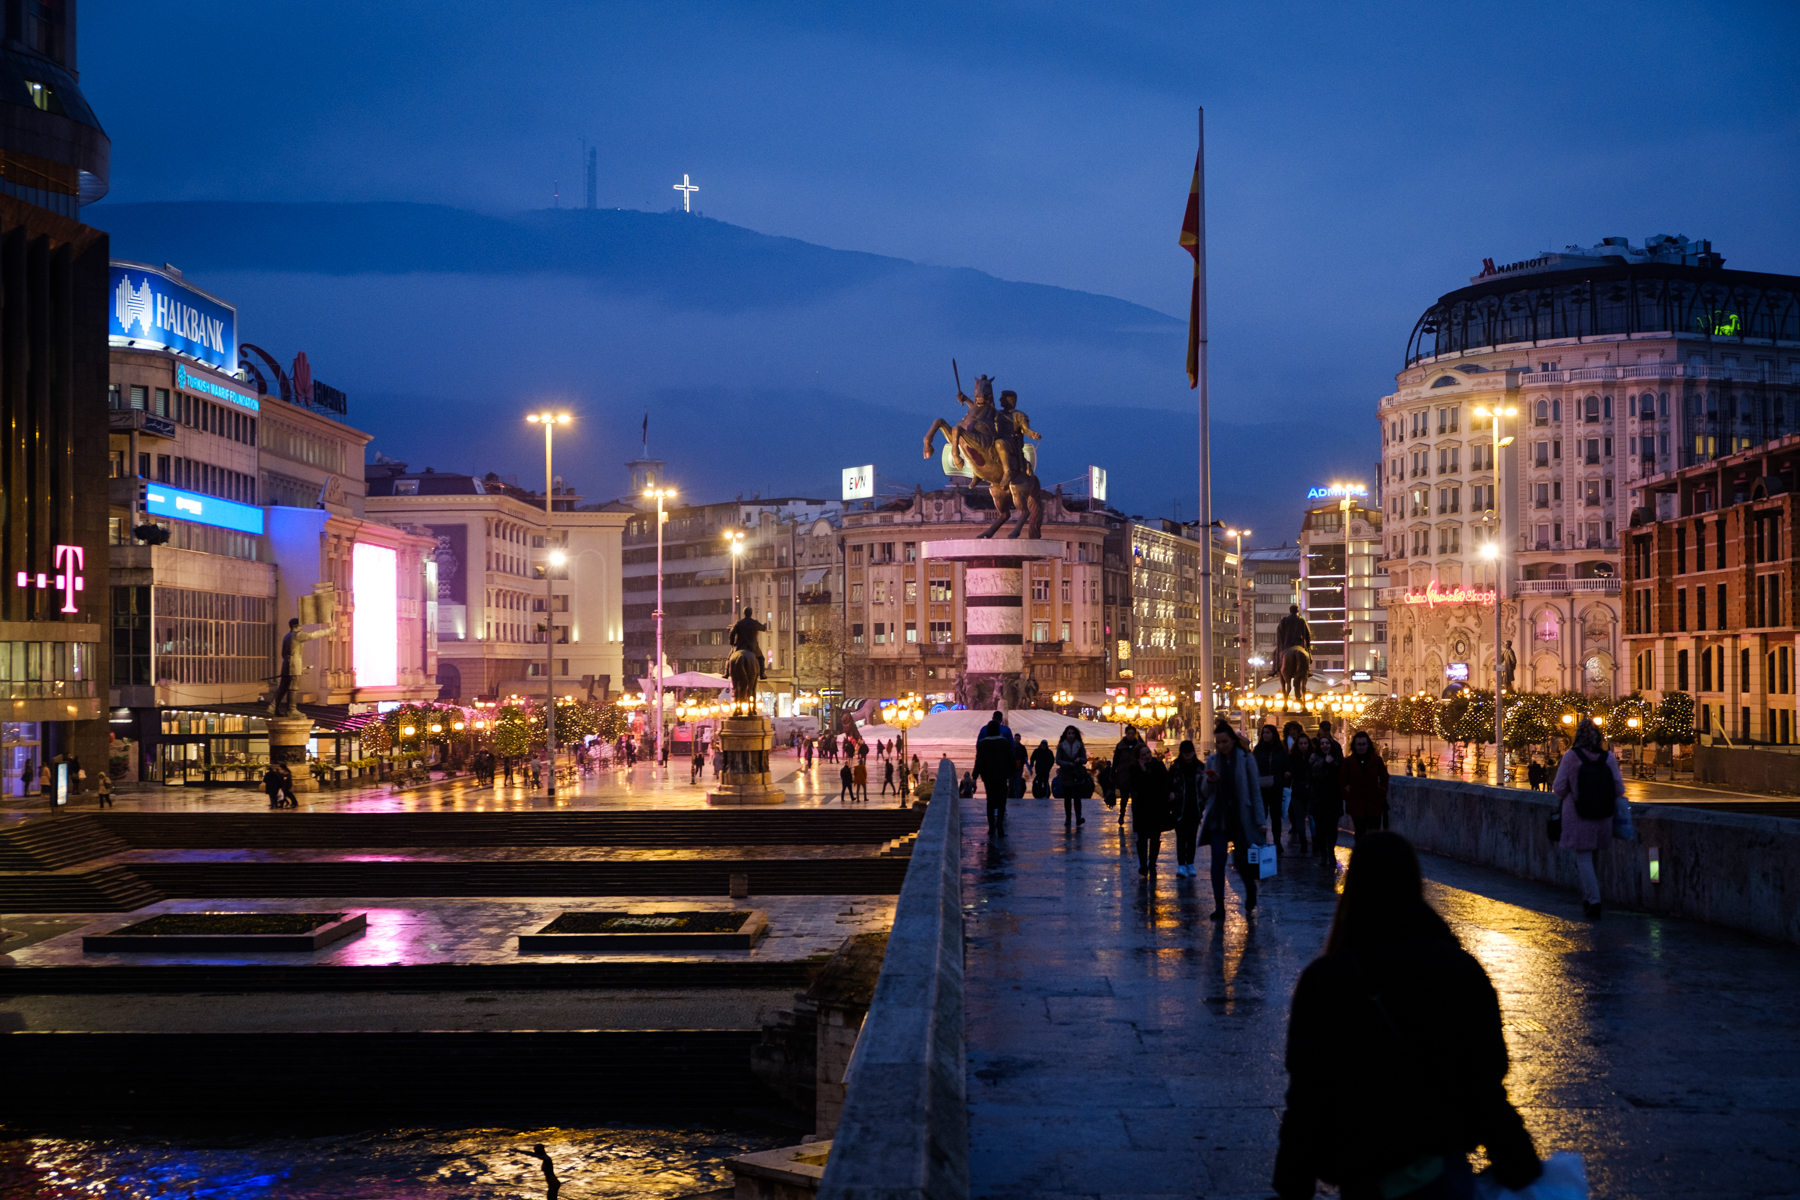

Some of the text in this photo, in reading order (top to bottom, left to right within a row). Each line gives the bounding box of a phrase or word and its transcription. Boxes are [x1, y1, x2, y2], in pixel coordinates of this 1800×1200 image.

[1498, 257, 1549, 273] MARRIOTT
[156, 293, 224, 354] HALKBANK
[186, 375, 209, 393] TURKISH
[229, 391, 259, 411] FOUNDATION
[314, 380, 346, 415] HUAWEI
[849, 475, 866, 491] EVN
[1404, 592, 1428, 604] Casino
